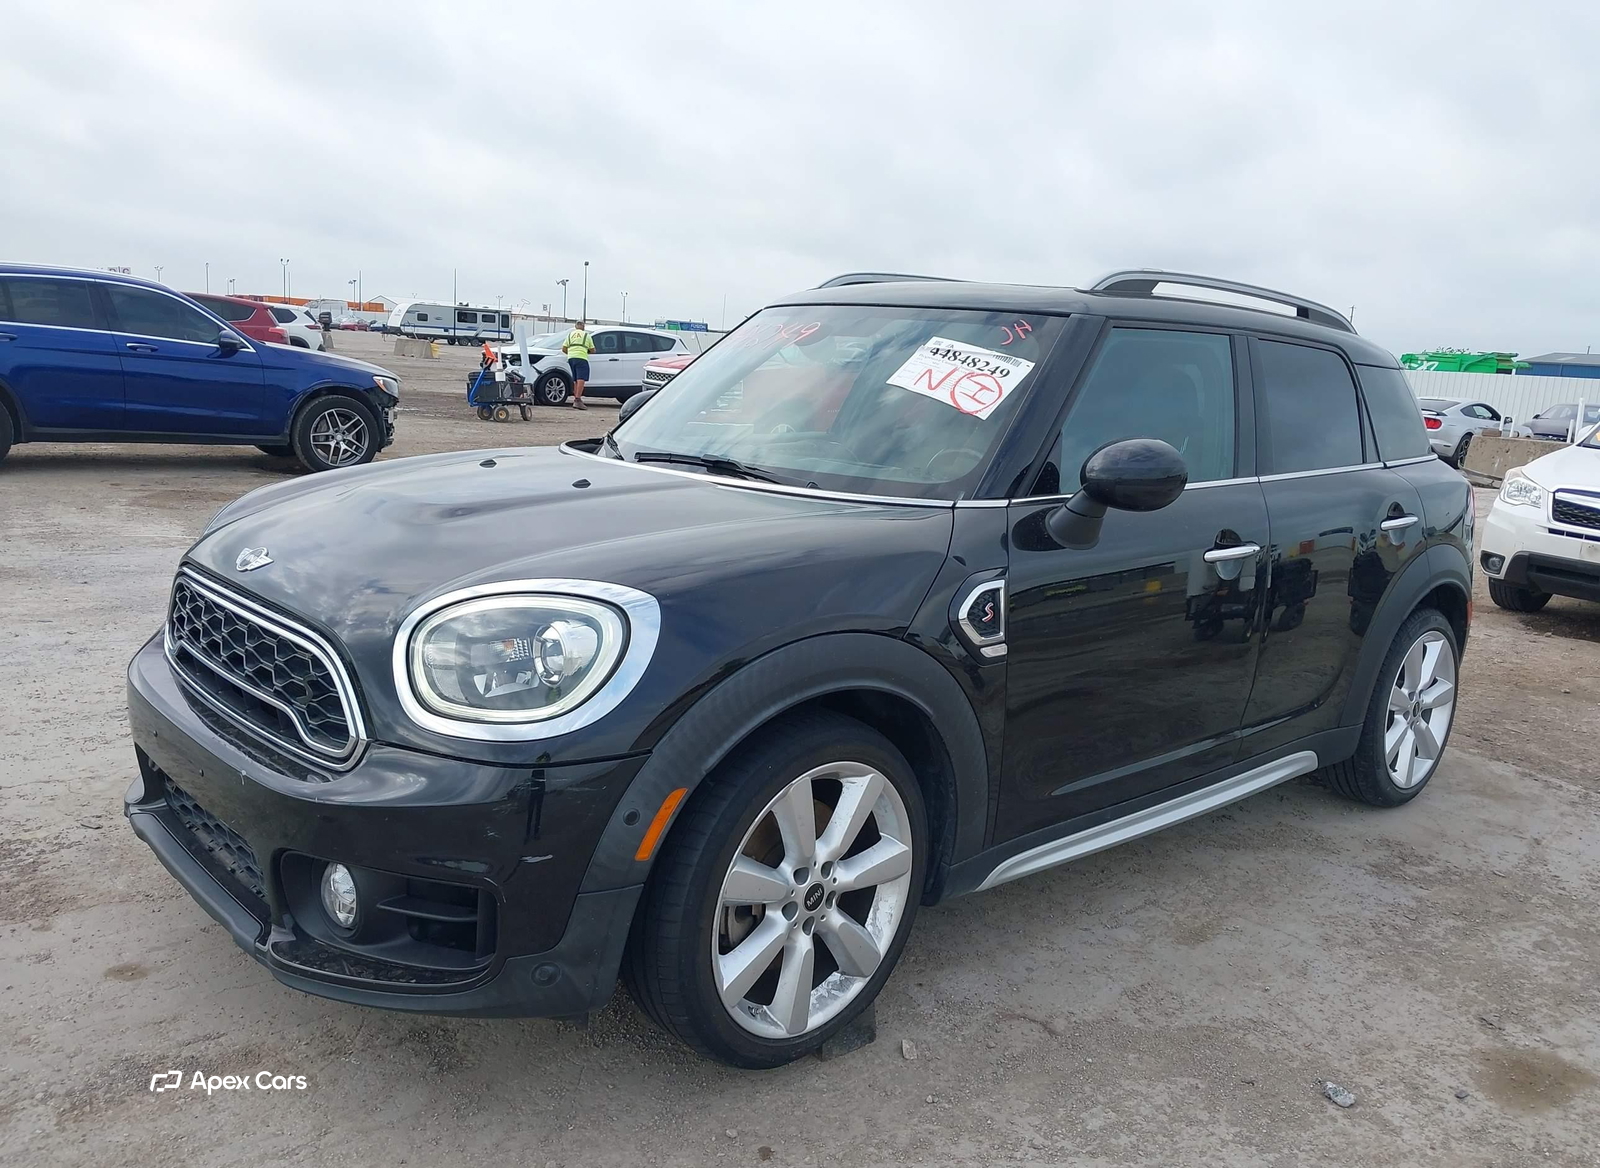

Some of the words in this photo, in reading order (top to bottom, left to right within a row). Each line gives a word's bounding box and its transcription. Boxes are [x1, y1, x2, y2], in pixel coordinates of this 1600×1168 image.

[929, 346, 1010, 379] 44848249
[913, 366, 958, 391] N
[981, 602, 994, 623] S
[806, 887, 823, 907] MINI
